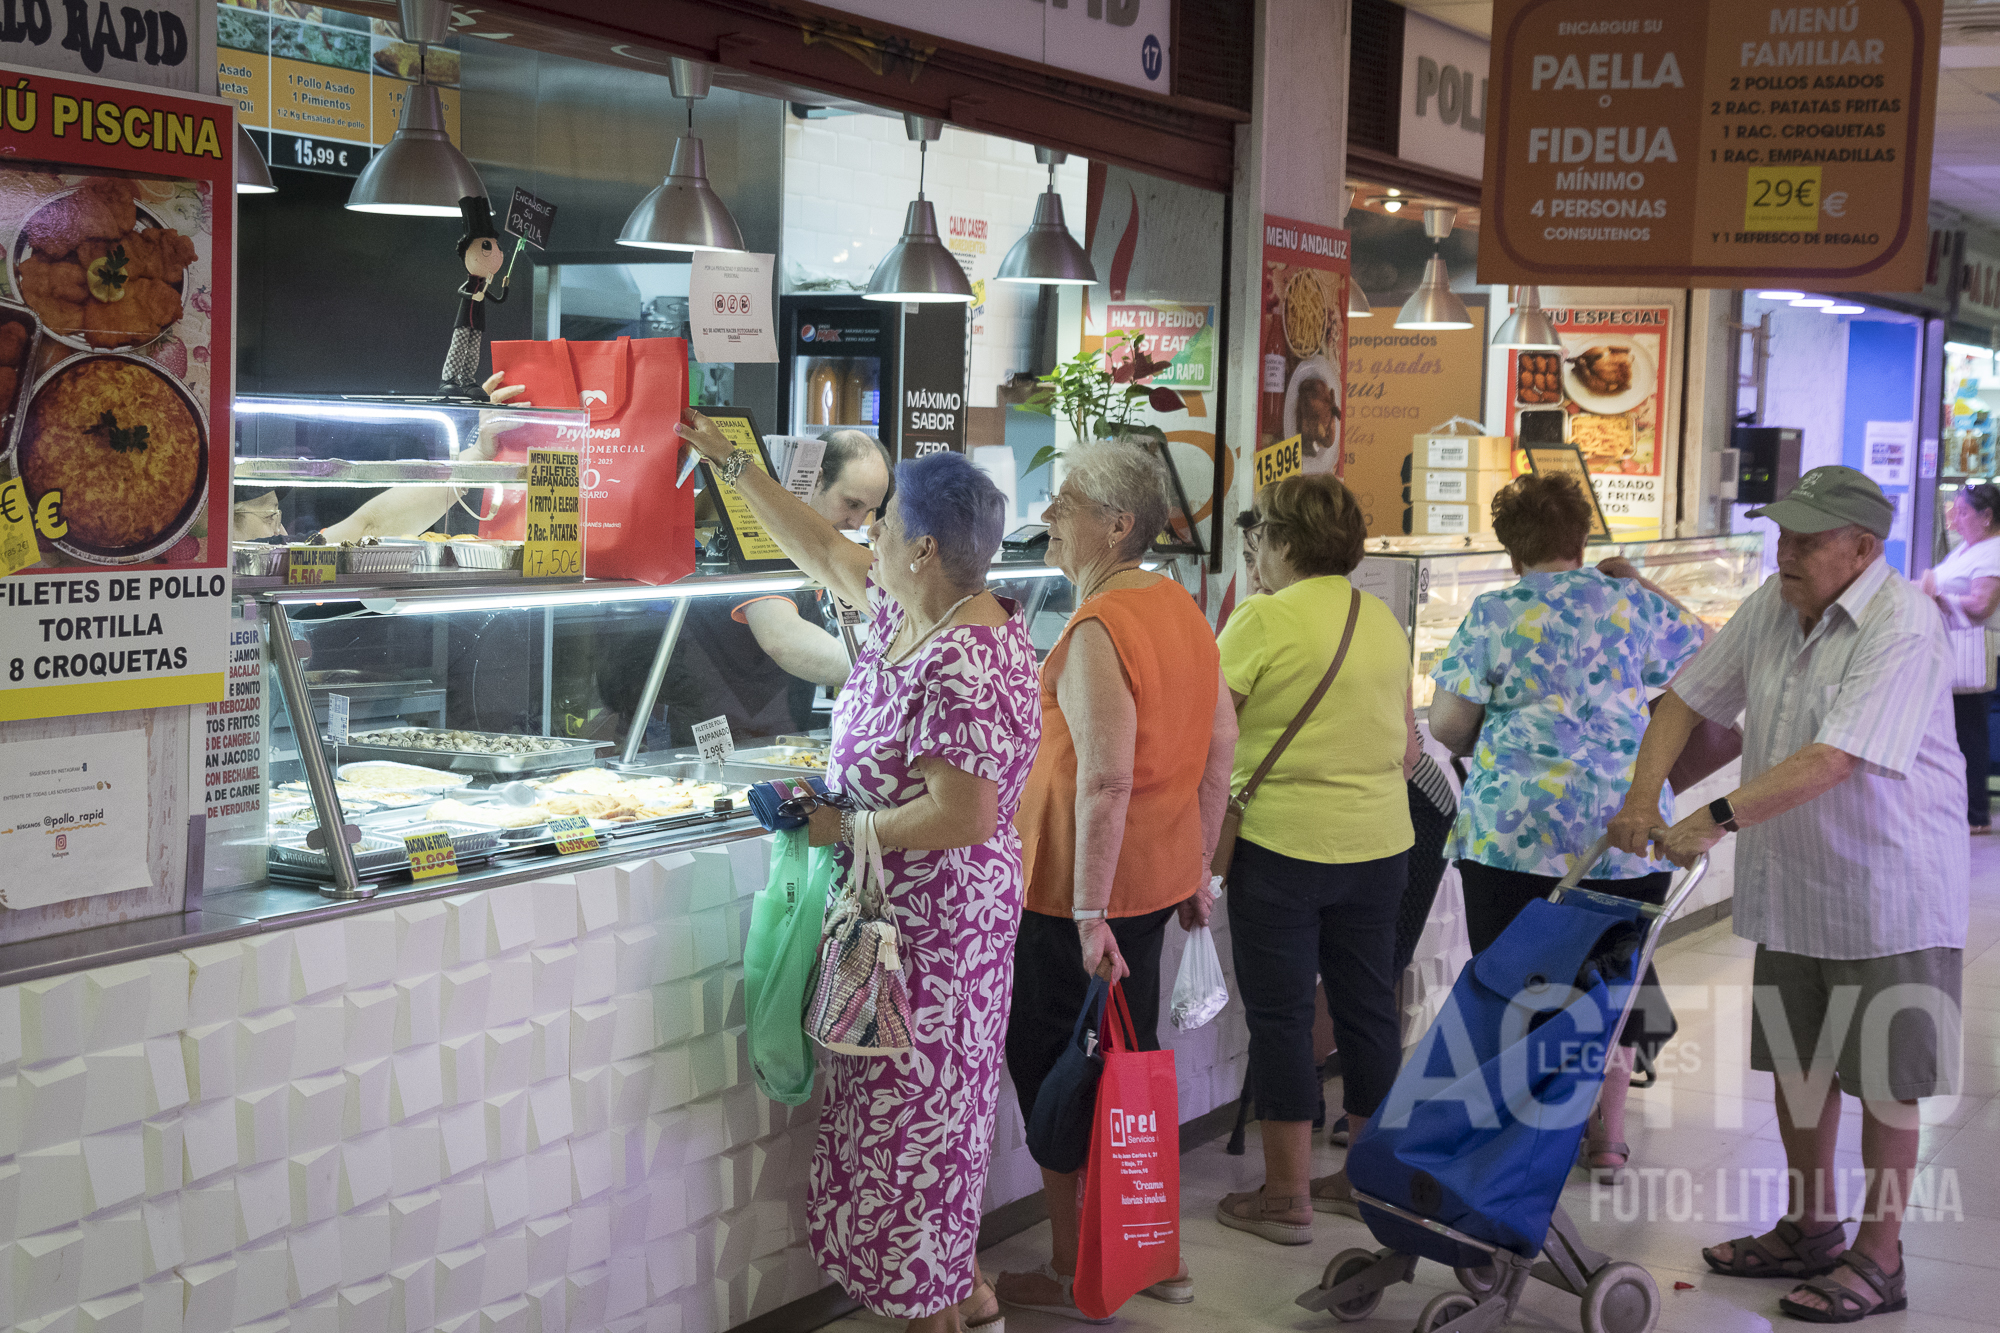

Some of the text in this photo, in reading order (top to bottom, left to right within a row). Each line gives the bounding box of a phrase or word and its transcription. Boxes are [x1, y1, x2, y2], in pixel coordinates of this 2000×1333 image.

[1769, 1, 1859, 34] MENÚ
[62, 0, 188, 73] RAPID
[1558, 20, 1663, 36] ENCARGUE SU
[1144, 44, 1159, 71] 17
[1740, 38, 1885, 67] FAMILIAR
[218, 62, 253, 78] Asado
[1531, 52, 1685, 91] PAELLA
[288, 74, 356, 96] 1 Pollo Asado
[1730, 74, 1885, 91] 2 POLLOS ASADOS
[293, 91, 351, 111] 1 Pimientos
[1711, 99, 1901, 115] 2 RAC. PATATAS FRITAS
[0, 78, 223, 159] Ú PISCINA
[290, 110, 366, 131] Kg Ensalada de pollo
[1723, 123, 1886, 139] 1 RAC. CROQUETAS
[294, 138, 348, 167] 15,99 €
[1528, 126, 1678, 164] FIDEUA
[1711, 148, 1895, 163] 1 RAC. EMPANADILLAS
[1556, 166, 1645, 191] MÍNIMO
[1753, 178, 1816, 207] 29€
[515, 190, 552, 217] ENCARGUE
[1530, 199, 1667, 219] 4 PERSONAS
[1822, 191, 1848, 217] €
[523, 208, 533, 220] SU
[949, 215, 988, 240] CALDO CASERO
[1543, 227, 1651, 241] CONSULTENOS
[1266, 225, 1347, 260] MENÚ ANDALUZ
[1712, 232, 1880, 245] Y 1 REFRESCO DE REGALO
[1111, 310, 1205, 328] HAZ TU PEDIDO
[1573, 310, 1665, 326] ESPECIAL
[1160, 335, 1190, 352] EAT
[1349, 333, 1438, 349] preparados
[1176, 363, 1205, 380] RAPID
[907, 388, 961, 411] MÁXIMO
[912, 412, 955, 430] SABOR
[1360, 405, 1419, 419] casera
[716, 420, 745, 428] SEMANAL
[581, 445, 645, 453] COMERCIAL
[531, 453, 578, 466] MENU FILETES
[1257, 441, 1300, 486] 15,99€
[532, 465, 576, 477] 4 FILETES
[531, 476, 579, 487] EMPANADOS
[1607, 479, 1654, 490] ASADO
[530, 496, 578, 513] 1 FRITO A ELEGIR
[1607, 490, 1655, 502] FRITAS
[34, 487, 69, 540] €
[528, 524, 577, 541] 2 Rac. PATATAS
[528, 549, 580, 577] 17,50€
[109, 578, 140, 601] DE
[150, 574, 225, 599] POLLO
[39, 613, 163, 642] TORTILLA
[230, 630, 259, 645] LEGIR
[9, 647, 187, 682] 8 CROQUETAS
[234, 648, 260, 663] JAMON
[236, 681, 260, 697] BONITO
[219, 697, 260, 714] REBOZADO
[206, 714, 260, 733] TOS FRITOS
[211, 731, 260, 750] DE CANGREJO
[699, 727, 730, 744] EMPANADO
[205, 748, 260, 768] AN JACOBO
[205, 766, 260, 786] CON BECHAMEL
[205, 784, 260, 803] A DE CARNE
[16, 808, 104, 830] BÚSCANOS @pollo_rapid
[208, 800, 260, 819] DE VERDURAS
[1126, 1110, 1157, 1133] red
[1128, 1135, 1155, 1143] Servicios
